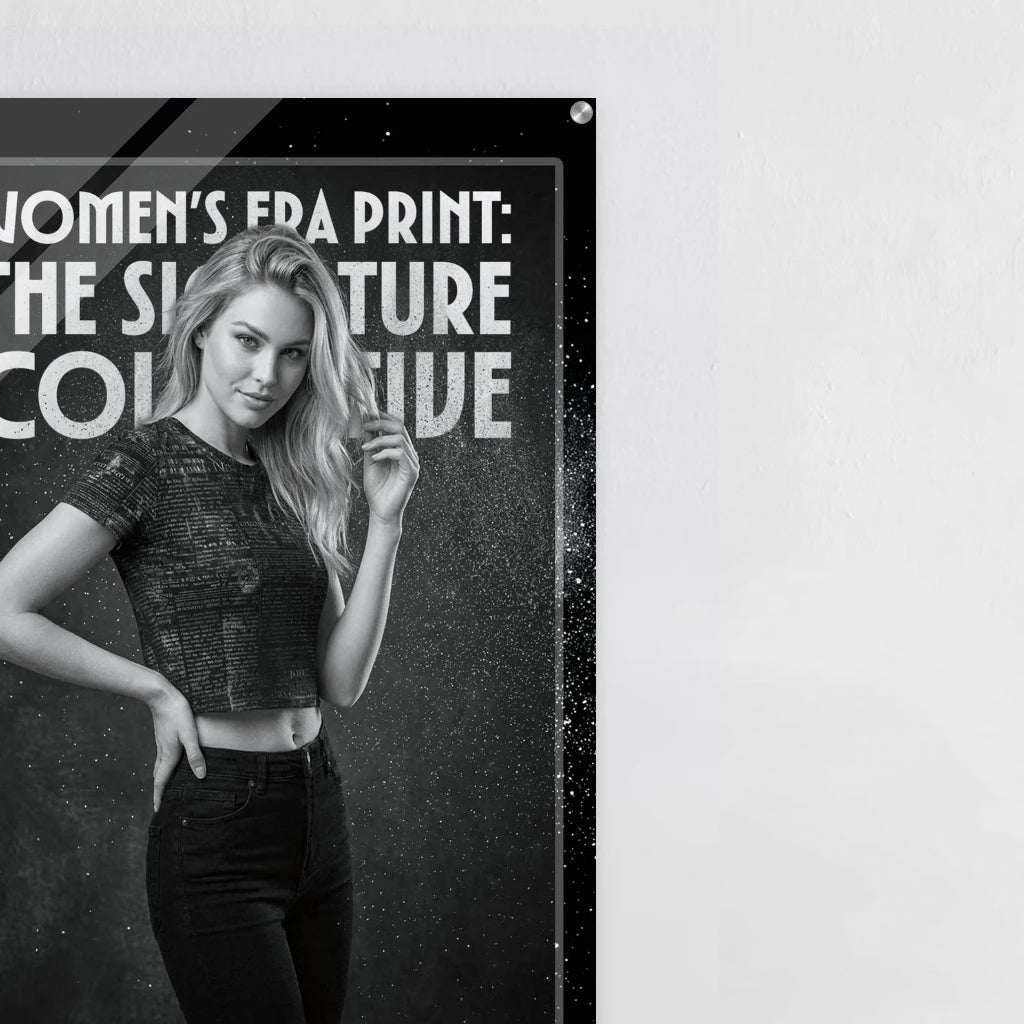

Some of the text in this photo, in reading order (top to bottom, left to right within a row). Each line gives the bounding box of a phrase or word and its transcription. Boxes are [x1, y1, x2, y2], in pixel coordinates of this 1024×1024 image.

[246, 187, 339, 244] ERA
[353, 190, 512, 244] PRINT:
[121, 260, 512, 336] SITURE
